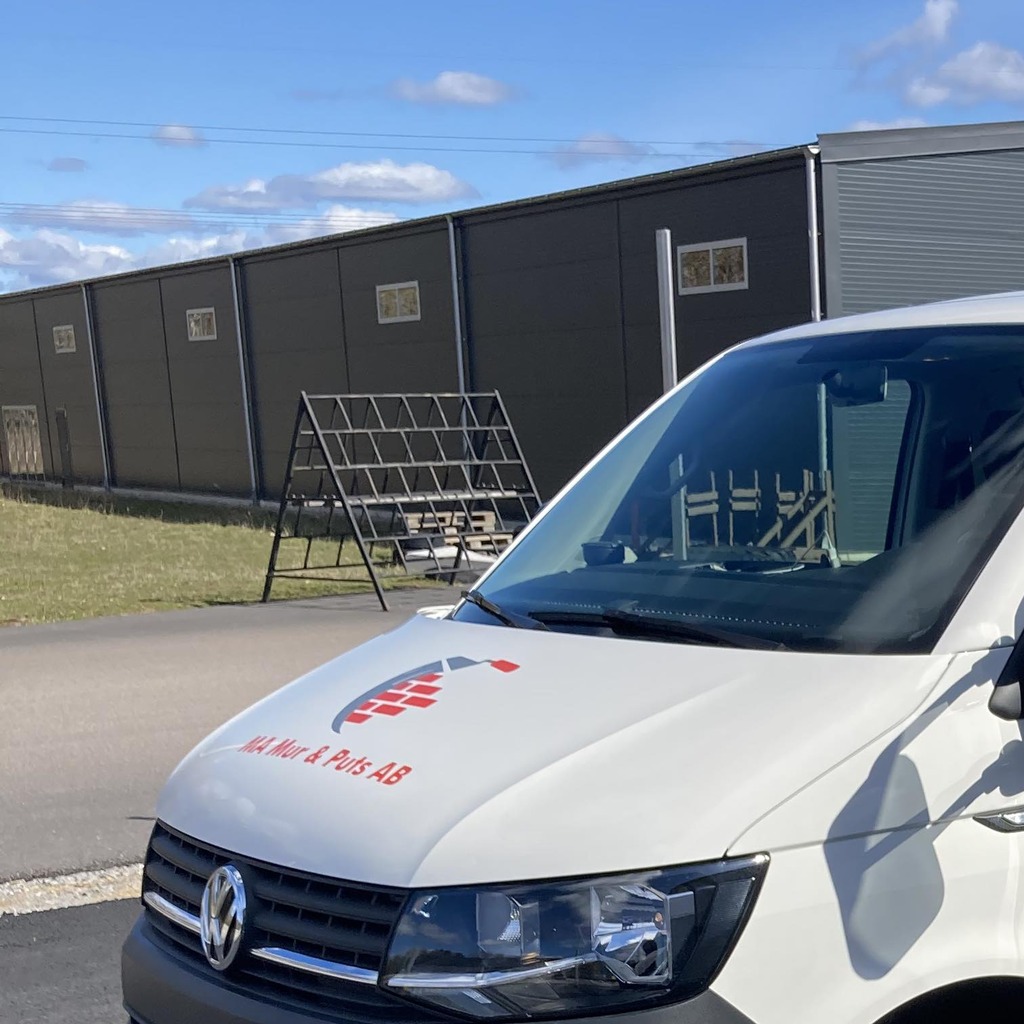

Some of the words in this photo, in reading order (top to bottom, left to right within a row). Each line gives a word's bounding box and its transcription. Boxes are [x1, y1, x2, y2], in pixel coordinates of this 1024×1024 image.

[238, 736, 276, 754] MA
[265, 739, 310, 759] Mur
[305, 746, 329, 764] &
[322, 749, 372, 775] Puts
[366, 762, 412, 785] AB
